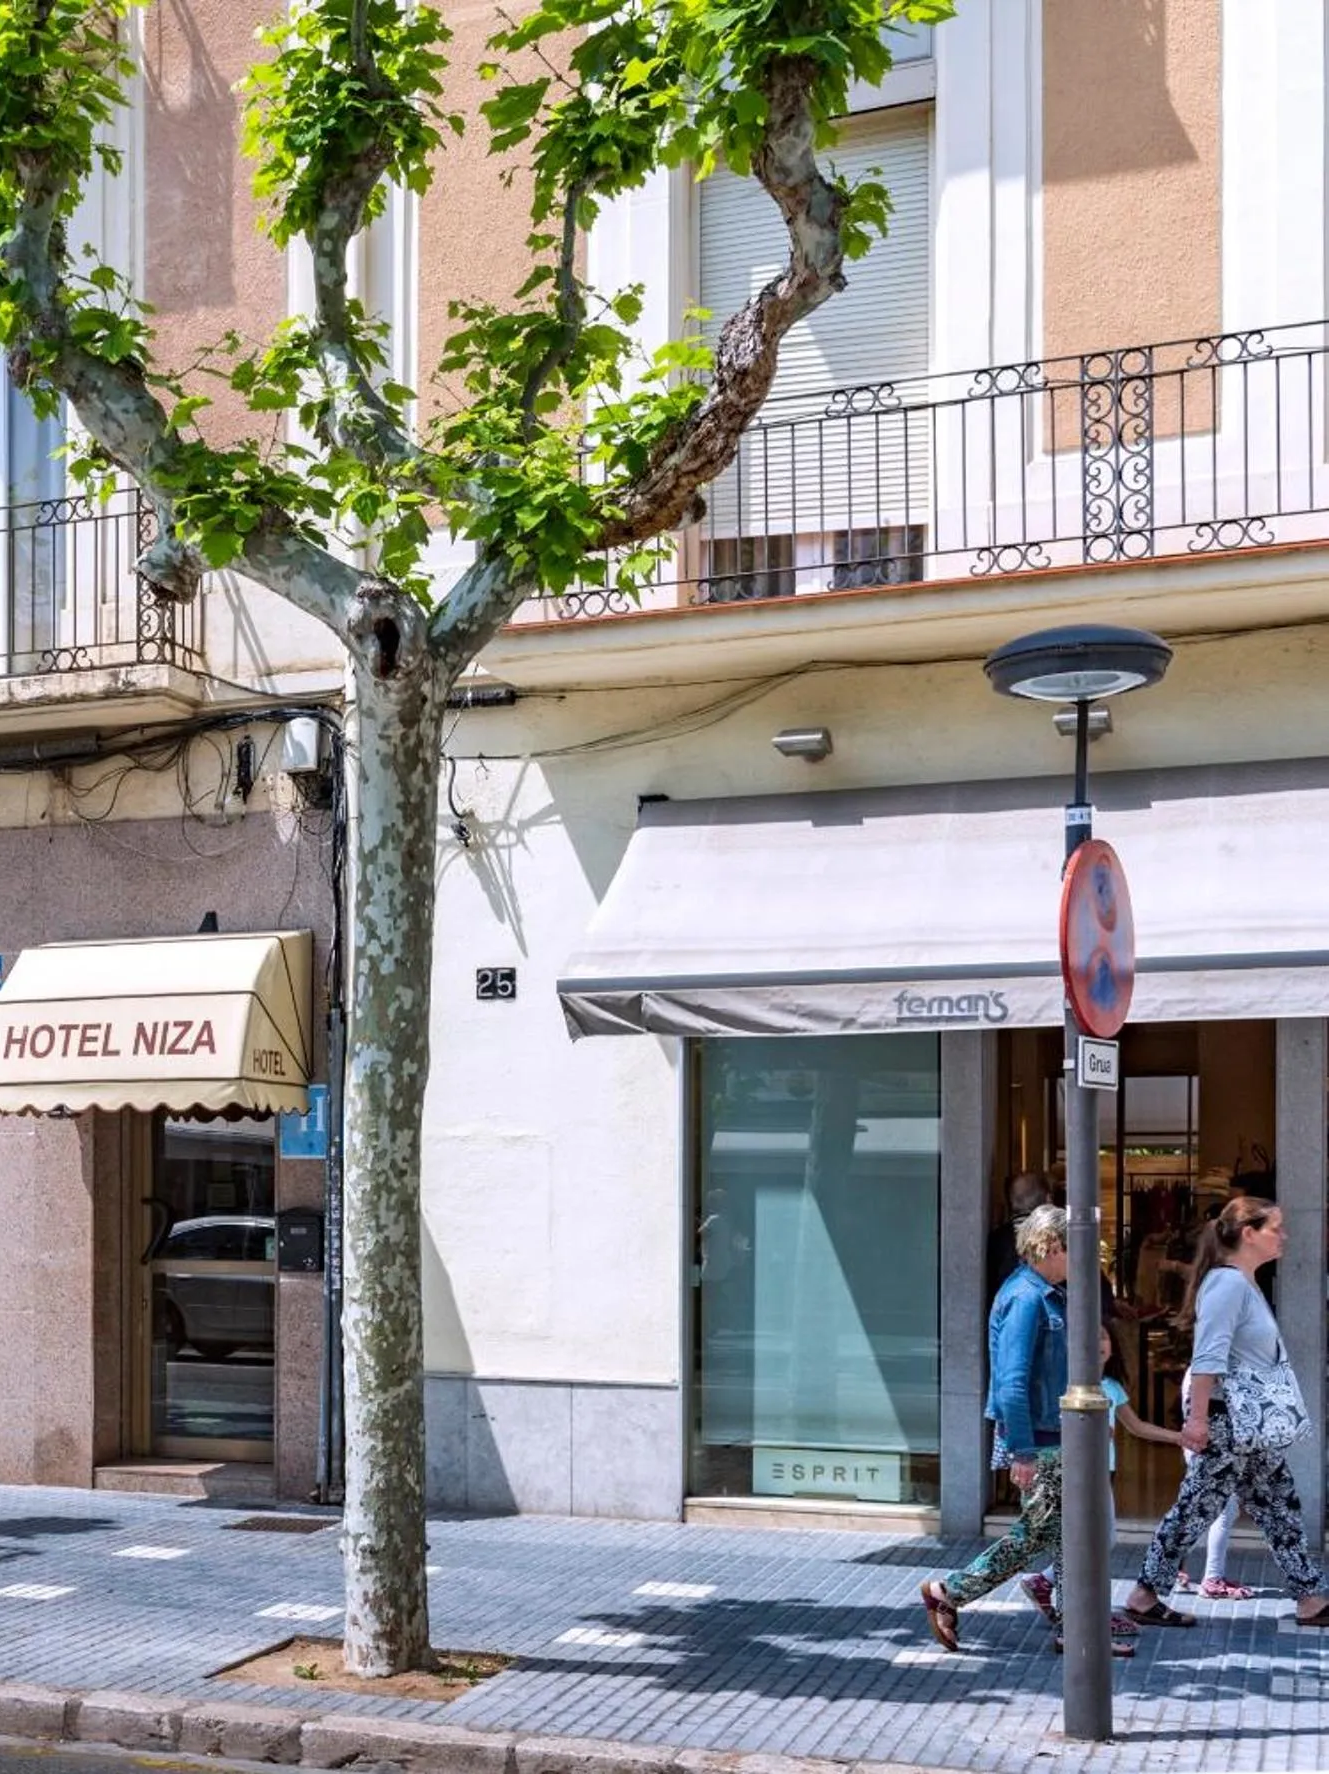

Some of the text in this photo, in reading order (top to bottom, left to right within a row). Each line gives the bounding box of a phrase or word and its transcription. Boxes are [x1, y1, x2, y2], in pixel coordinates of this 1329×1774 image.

[478, 970, 512, 995] 25
[3, 1020, 217, 1059] HOTEL NIZA
[253, 1048, 286, 1077] HOTEL
[1089, 1053, 1112, 1073] Grua
[772, 1463, 880, 1483] ESPRIT
